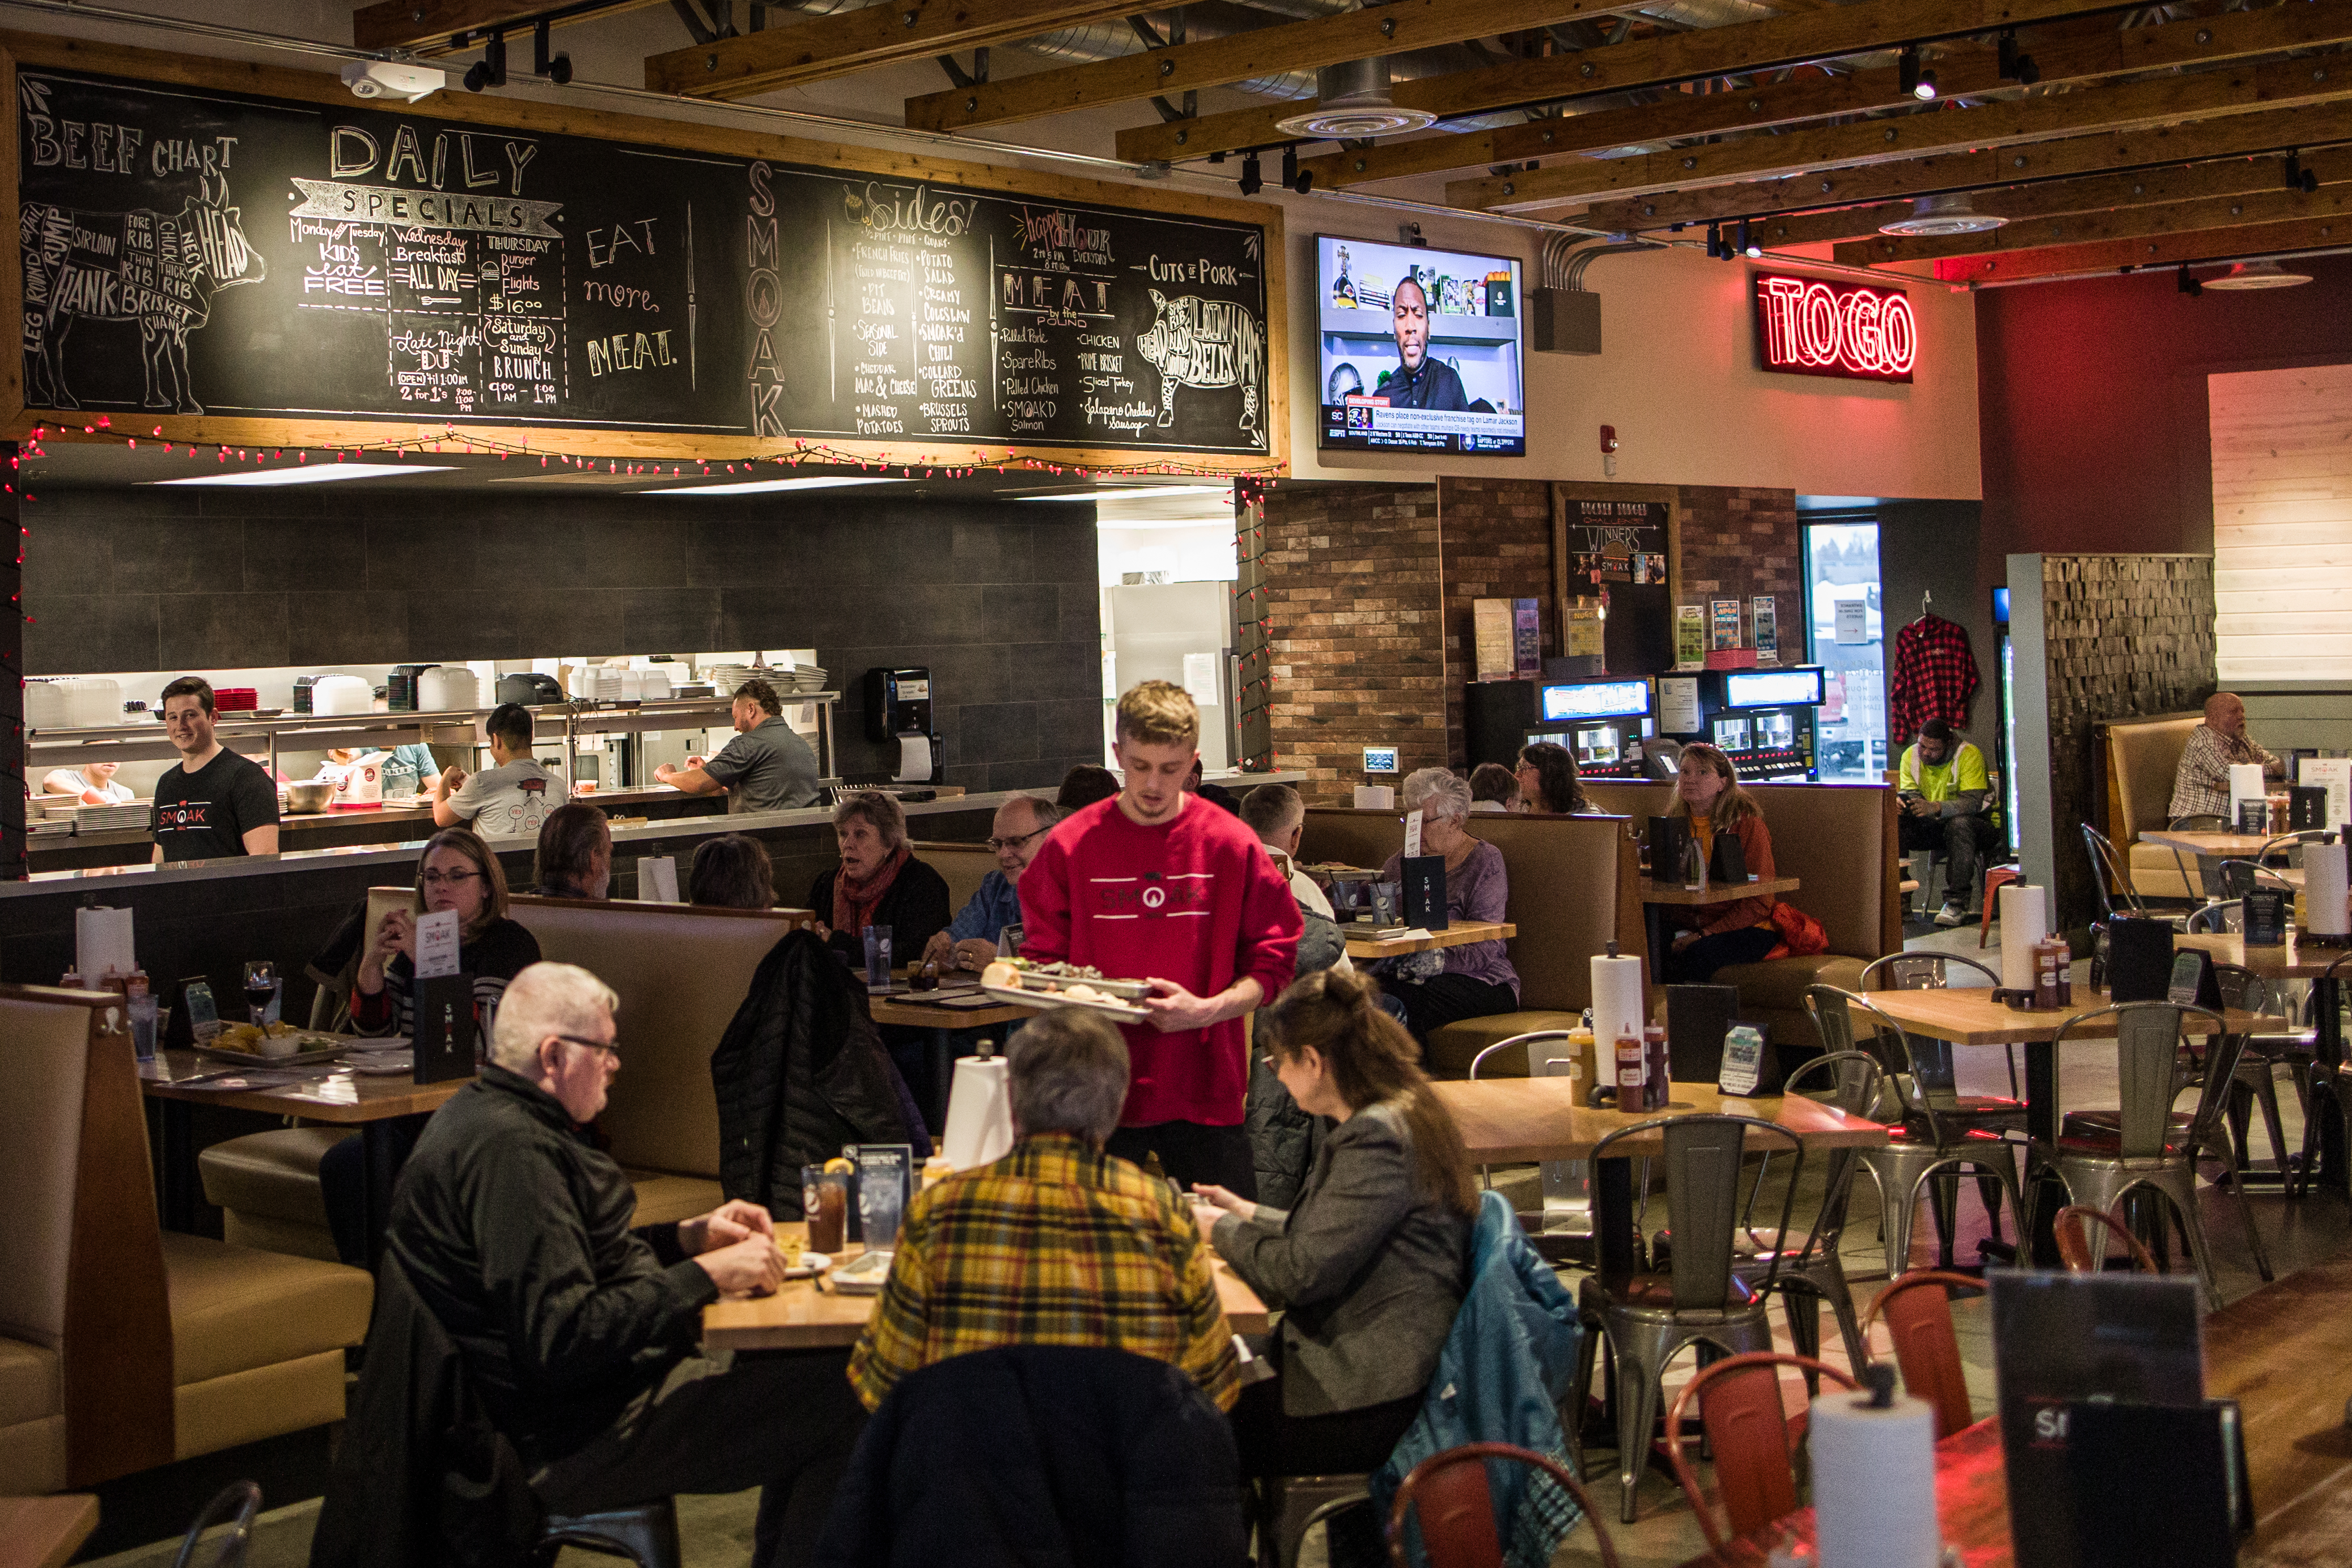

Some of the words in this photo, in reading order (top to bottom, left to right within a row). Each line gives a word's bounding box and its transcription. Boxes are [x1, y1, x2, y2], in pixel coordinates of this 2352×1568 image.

[27, 113, 143, 174] BEEF
[152, 137, 238, 176] CHART
[330, 124, 537, 195] DAILY
[343, 190, 523, 230] SPECIALS
[20, 204, 45, 243] OXTAIL
[128, 215, 150, 230] FORE
[290, 218, 333, 248] Monday
[345, 223, 384, 247] Tuesday
[44, 207, 72, 266] RUMP
[74, 227, 116, 257] SIRLOIN
[127, 229, 152, 249] RIB
[159, 222, 177, 262] CHUCK
[195, 206, 248, 279] HEAD
[392, 226, 467, 254] Wednesday
[486, 236, 550, 253] THURSDAY
[587, 218, 657, 268] EAT
[874, 231, 891, 241] PINT
[898, 232, 916, 244] PINT
[924, 234, 947, 248] QUART
[1023, 206, 1067, 252] happy
[1058, 214, 1115, 262] HOUR
[128, 252, 152, 267] THIN
[181, 232, 204, 282] NECK
[319, 243, 360, 262] KIDS
[392, 246, 465, 265] Breakfast
[856, 243, 888, 261] FRENCH
[889, 245, 909, 264] FRIES
[921, 249, 952, 268] POTATO
[1033, 248, 1038, 258] 2
[1054, 251, 1065, 261] PM
[1073, 249, 1107, 265] EVERYDAY
[122, 261, 153, 286] RIB
[159, 262, 188, 280] THICK
[307, 262, 377, 278] eat
[502, 254, 536, 276] Burger
[1045, 260, 1049, 269] 8
[1149, 254, 1184, 282] CUTS
[1188, 265, 1196, 277] OF
[1200, 258, 1237, 286] PORK
[26, 253, 47, 303] ROUND
[304, 276, 385, 295] FREE
[409, 264, 434, 290] ALL
[438, 265, 459, 292] DAY
[502, 275, 539, 297] Flights
[925, 266, 955, 285] SALAD
[48, 264, 118, 331] FLANK
[163, 277, 192, 299] RIB
[868, 283, 885, 297] PIT
[924, 285, 960, 305] CREAMY
[1004, 273, 1111, 312] MEAT
[121, 285, 192, 324] BRISKET
[862, 296, 895, 316] BEANS
[1154, 292, 1166, 311] EAR
[1169, 298, 1189, 315] SPARE
[924, 302, 970, 324] COLESLAW
[1037, 316, 1087, 328] POUND
[1050, 311, 1059, 323] by
[1063, 309, 1077, 319] the
[1169, 310, 1185, 330] RIB
[1192, 299, 1230, 340] LOIN
[24, 312, 44, 352] LEG
[145, 315, 185, 349] SHANK
[393, 330, 438, 355] Late
[438, 326, 480, 356] Night
[492, 319, 546, 342] Saturday
[857, 319, 899, 342] SEASONAL
[1002, 326, 1025, 342] Pulled
[1027, 328, 1048, 344] Pork
[1169, 317, 1190, 353] BLADE
[499, 338, 541, 362] Sunday
[868, 340, 887, 357] SIDE
[1080, 334, 1120, 349] CHICKEN
[1140, 320, 1168, 367] HEAD
[1232, 305, 1260, 384] HAM
[421, 349, 452, 370] DJ
[587, 329, 677, 376] MEAT.
[929, 344, 952, 362] CHILI
[1003, 351, 1033, 376] Spare
[1035, 349, 1056, 370] Ribs
[1080, 353, 1097, 370] PRIME
[1100, 354, 1122, 372] BRISKET
[1185, 340, 1236, 383] BELLY
[494, 355, 552, 380] BRUNCH
[861, 362, 896, 375] CHEDDAR
[922, 366, 961, 379] COLLARD
[400, 374, 423, 383] OPEN
[855, 378, 874, 393] MAC
[875, 375, 887, 400] &
[890, 378, 916, 395] CHEESE
[931, 379, 977, 398] GREENS
[1006, 378, 1028, 395] Pulled
[1032, 377, 1058, 395] Chicken
[1083, 375, 1109, 392] Sliced
[1109, 376, 1133, 394] Turkey
[400, 386, 412, 400] 2
[414, 388, 430, 400] for
[503, 393, 516, 402] AM
[545, 394, 556, 404] PM
[1163, 377, 1174, 410] HOCK
[1246, 387, 1255, 417] HOCK
[862, 404, 897, 418] MASHED
[923, 402, 967, 417] BRUSSELS
[1125, 401, 1155, 417] Cheddar
[1396, 412, 1409, 421] place
[1410, 413, 1443, 421] non-exclusive
[857, 418, 903, 435] POTATOES
[931, 418, 969, 433] SPROUTS
[1011, 419, 1044, 432] Salmon
[1109, 416, 1149, 438] Sausage
[1587, 528, 1640, 552] WINNERS
[160, 808, 205, 825] SMOAK
